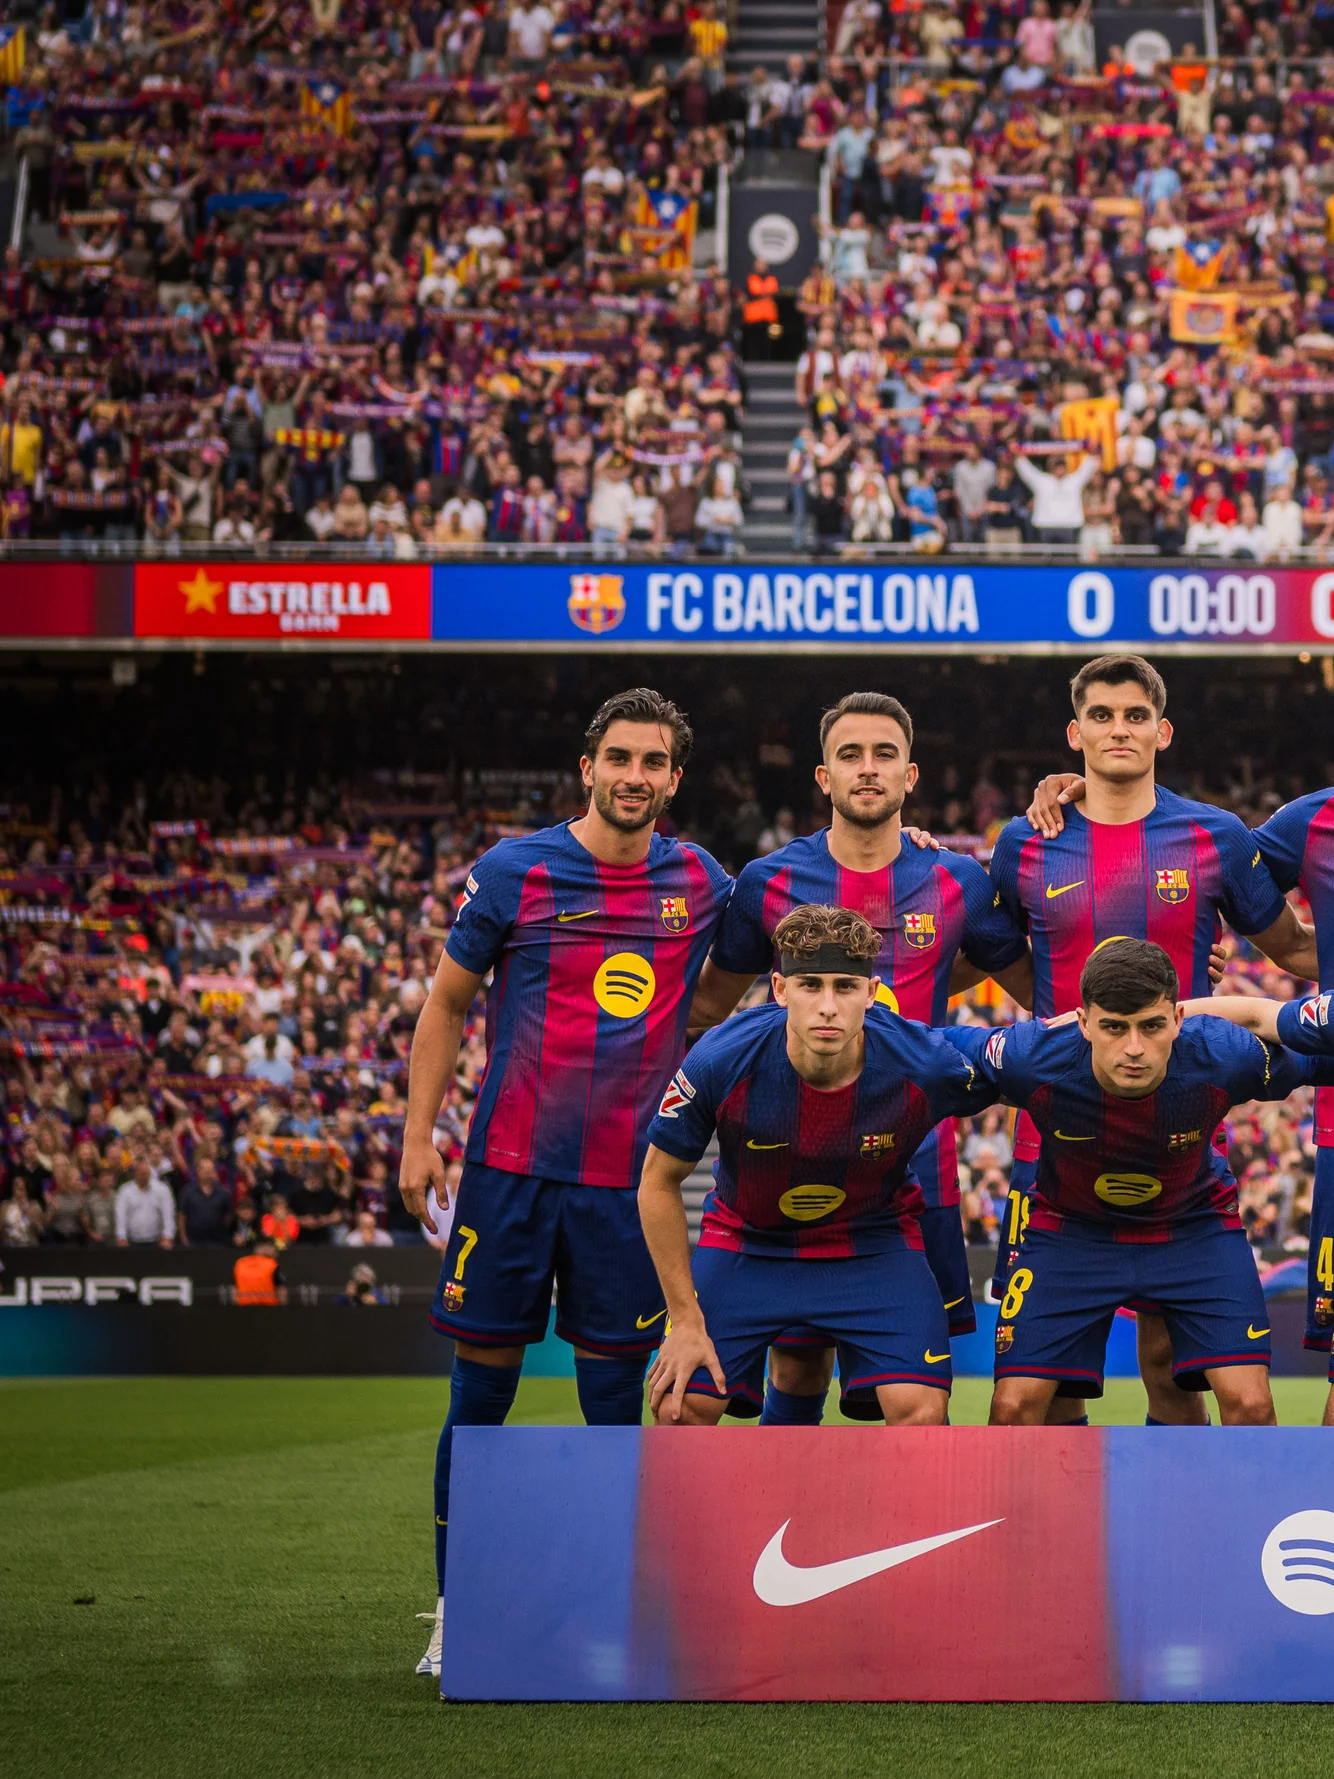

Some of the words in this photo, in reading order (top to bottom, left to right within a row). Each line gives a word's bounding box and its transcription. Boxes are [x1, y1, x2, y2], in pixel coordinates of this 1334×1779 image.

[228, 582, 391, 615] ESTRELLA
[647, 573, 703, 633] FC
[713, 573, 979, 633] BARCELONA
[1067, 571, 1114, 637] 0
[1150, 574, 1276, 635] 00:00
[453, 1225, 478, 1280] 7
[1317, 1236, 1334, 1291] 4
[1001, 1268, 1033, 1319] 8
